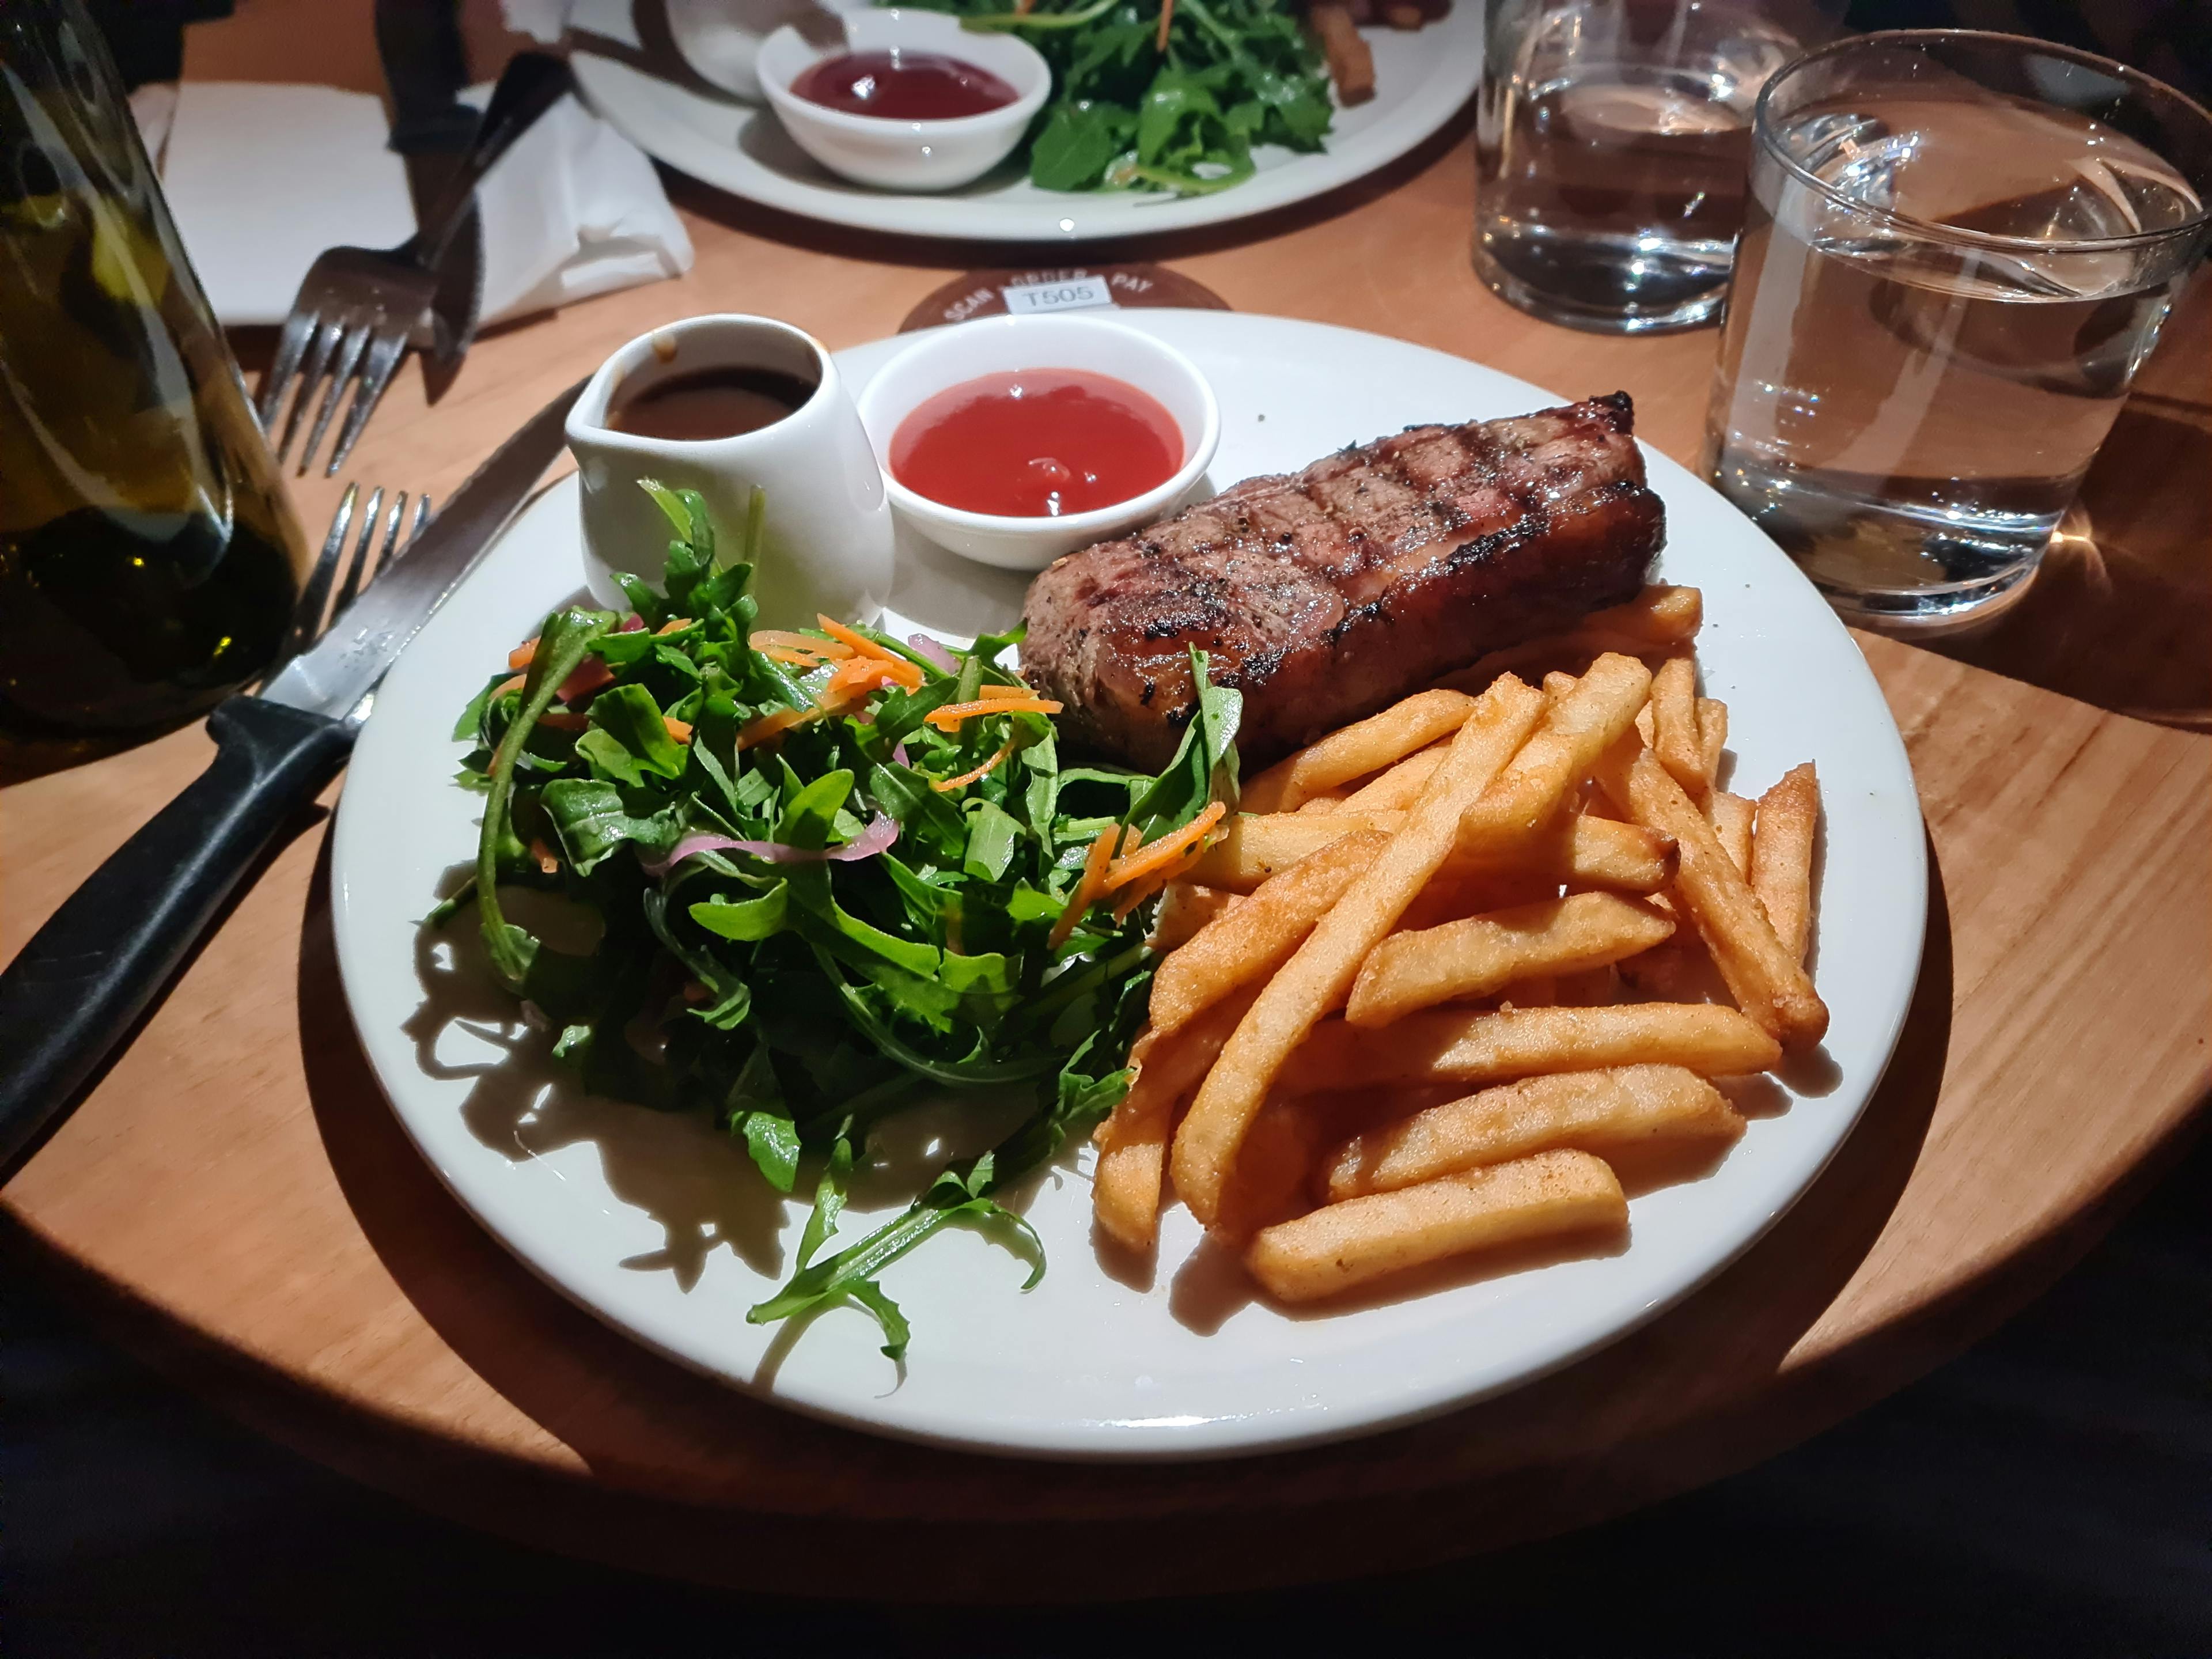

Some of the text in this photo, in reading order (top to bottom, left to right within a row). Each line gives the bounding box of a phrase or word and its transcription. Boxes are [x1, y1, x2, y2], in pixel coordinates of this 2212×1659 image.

[943, 287, 995, 321] SCAN
[1111, 272, 1153, 293] PAY
[1022, 286, 1093, 306] T505
